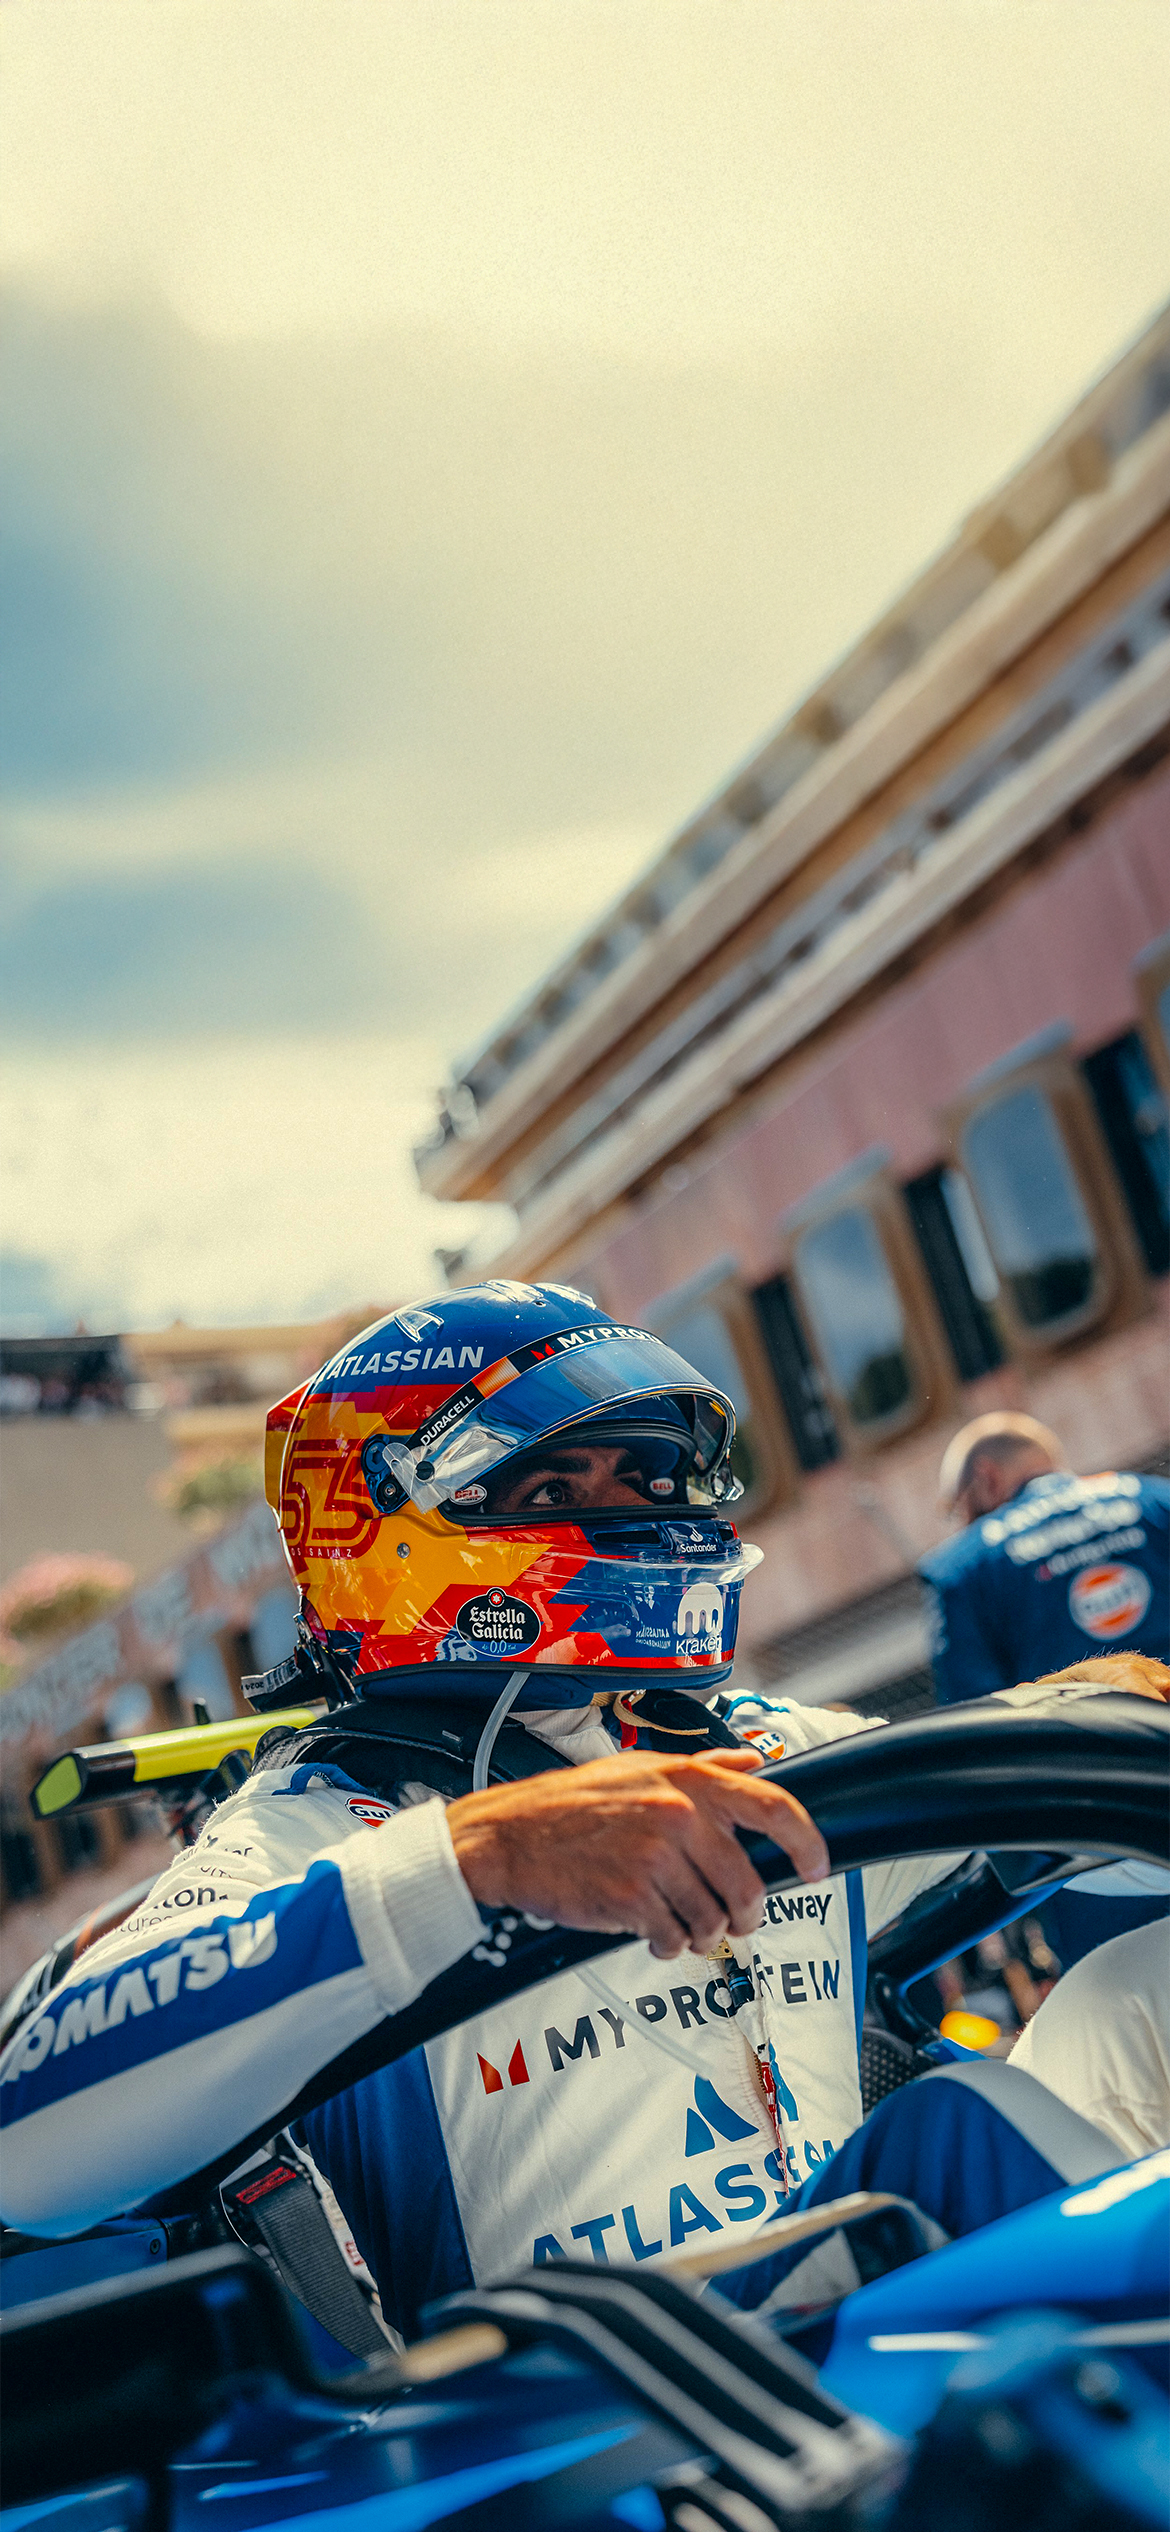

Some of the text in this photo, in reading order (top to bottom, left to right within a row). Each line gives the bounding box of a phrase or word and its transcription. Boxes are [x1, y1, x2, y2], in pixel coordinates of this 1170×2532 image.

[327, 1346, 484, 1380] ATLASSIAN
[420, 1395, 475, 1447] DURACELL
[652, 1482, 673, 1490] BELL
[309, 1547, 352, 1558] SAINZ
[680, 1543, 717, 1553] Santander
[469, 1606, 526, 1624] Estrella
[472, 1622, 523, 1640] Galicia
[489, 1640, 507, 1654] 0,0
[676, 1634, 722, 1654] kraken
[349, 1806, 394, 1820] Gul
[0, 1911, 278, 2085] OMATSU
